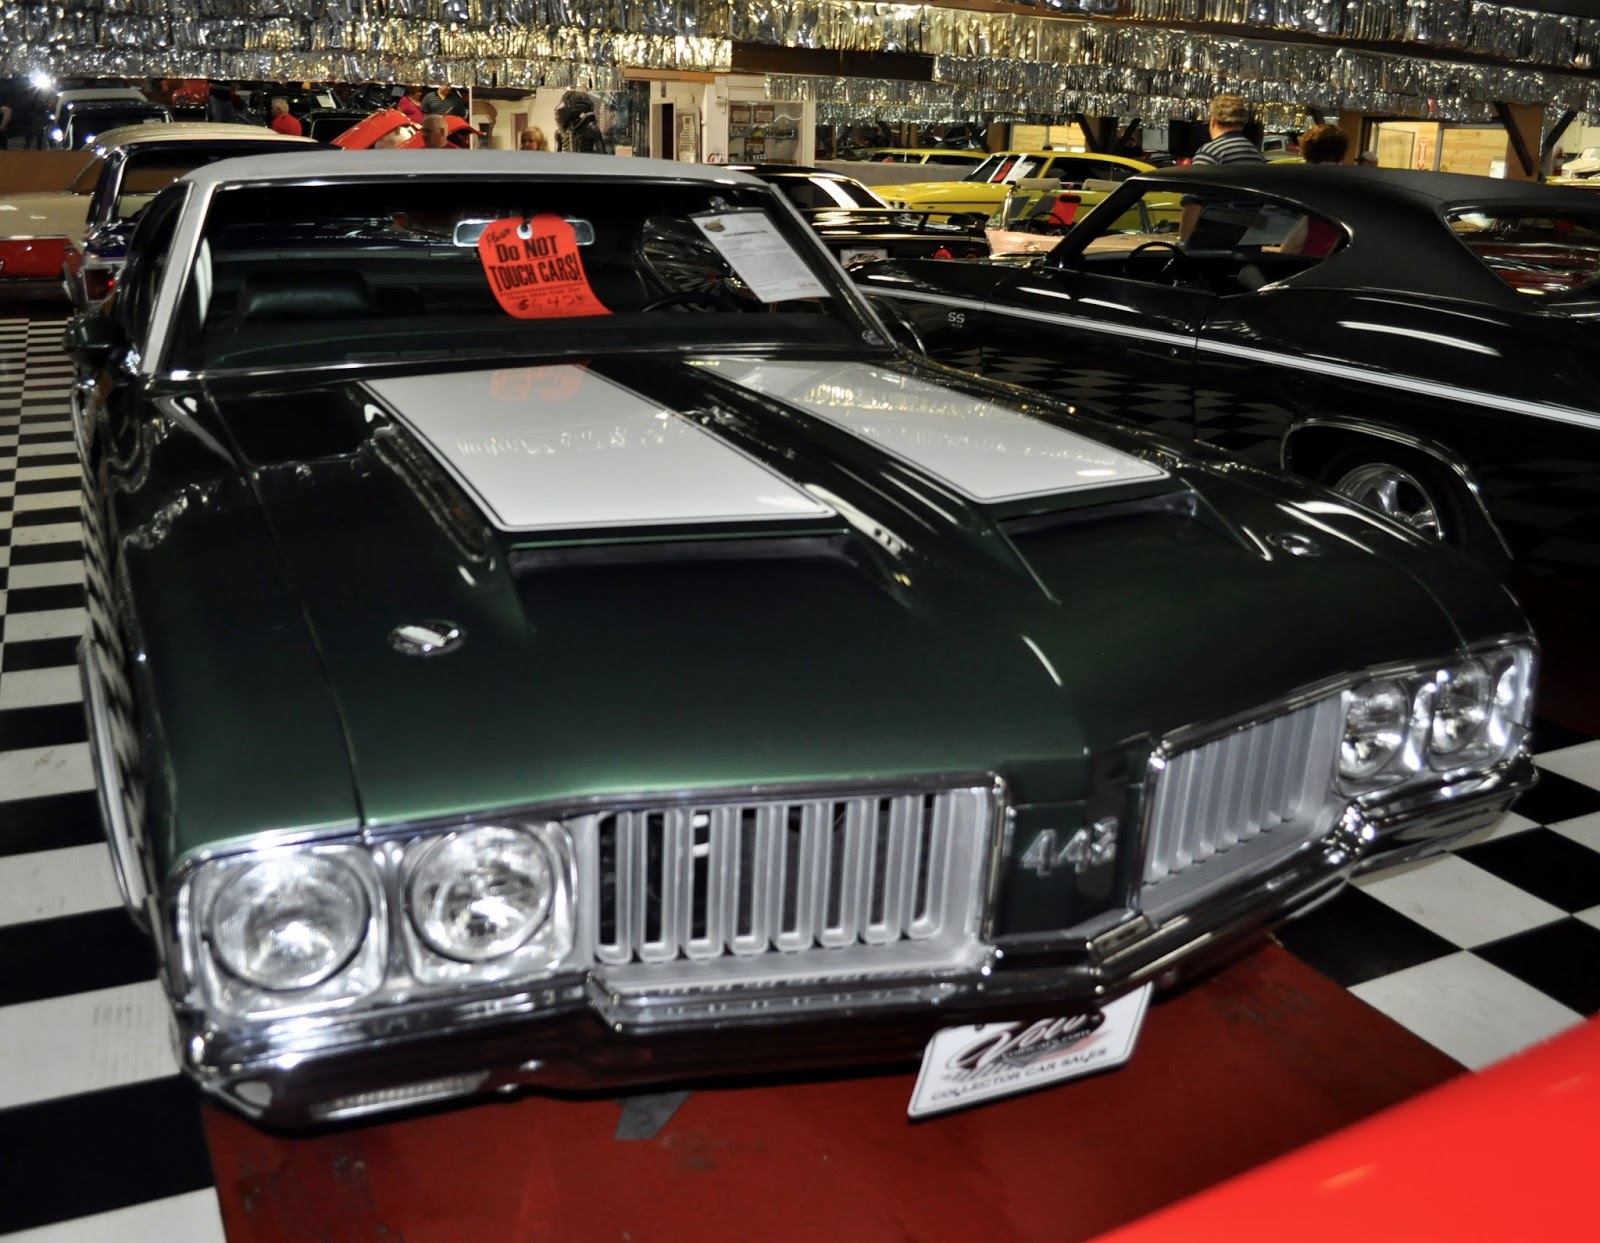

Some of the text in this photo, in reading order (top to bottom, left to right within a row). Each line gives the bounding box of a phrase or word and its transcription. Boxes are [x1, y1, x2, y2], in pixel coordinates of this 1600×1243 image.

[496, 235, 557, 263] Do NOT
[489, 253, 583, 292] TOUCH CARS!
[948, 312, 965, 323] SS
[931, 1047, 1107, 1101] COLLECTOR CAR SALES
